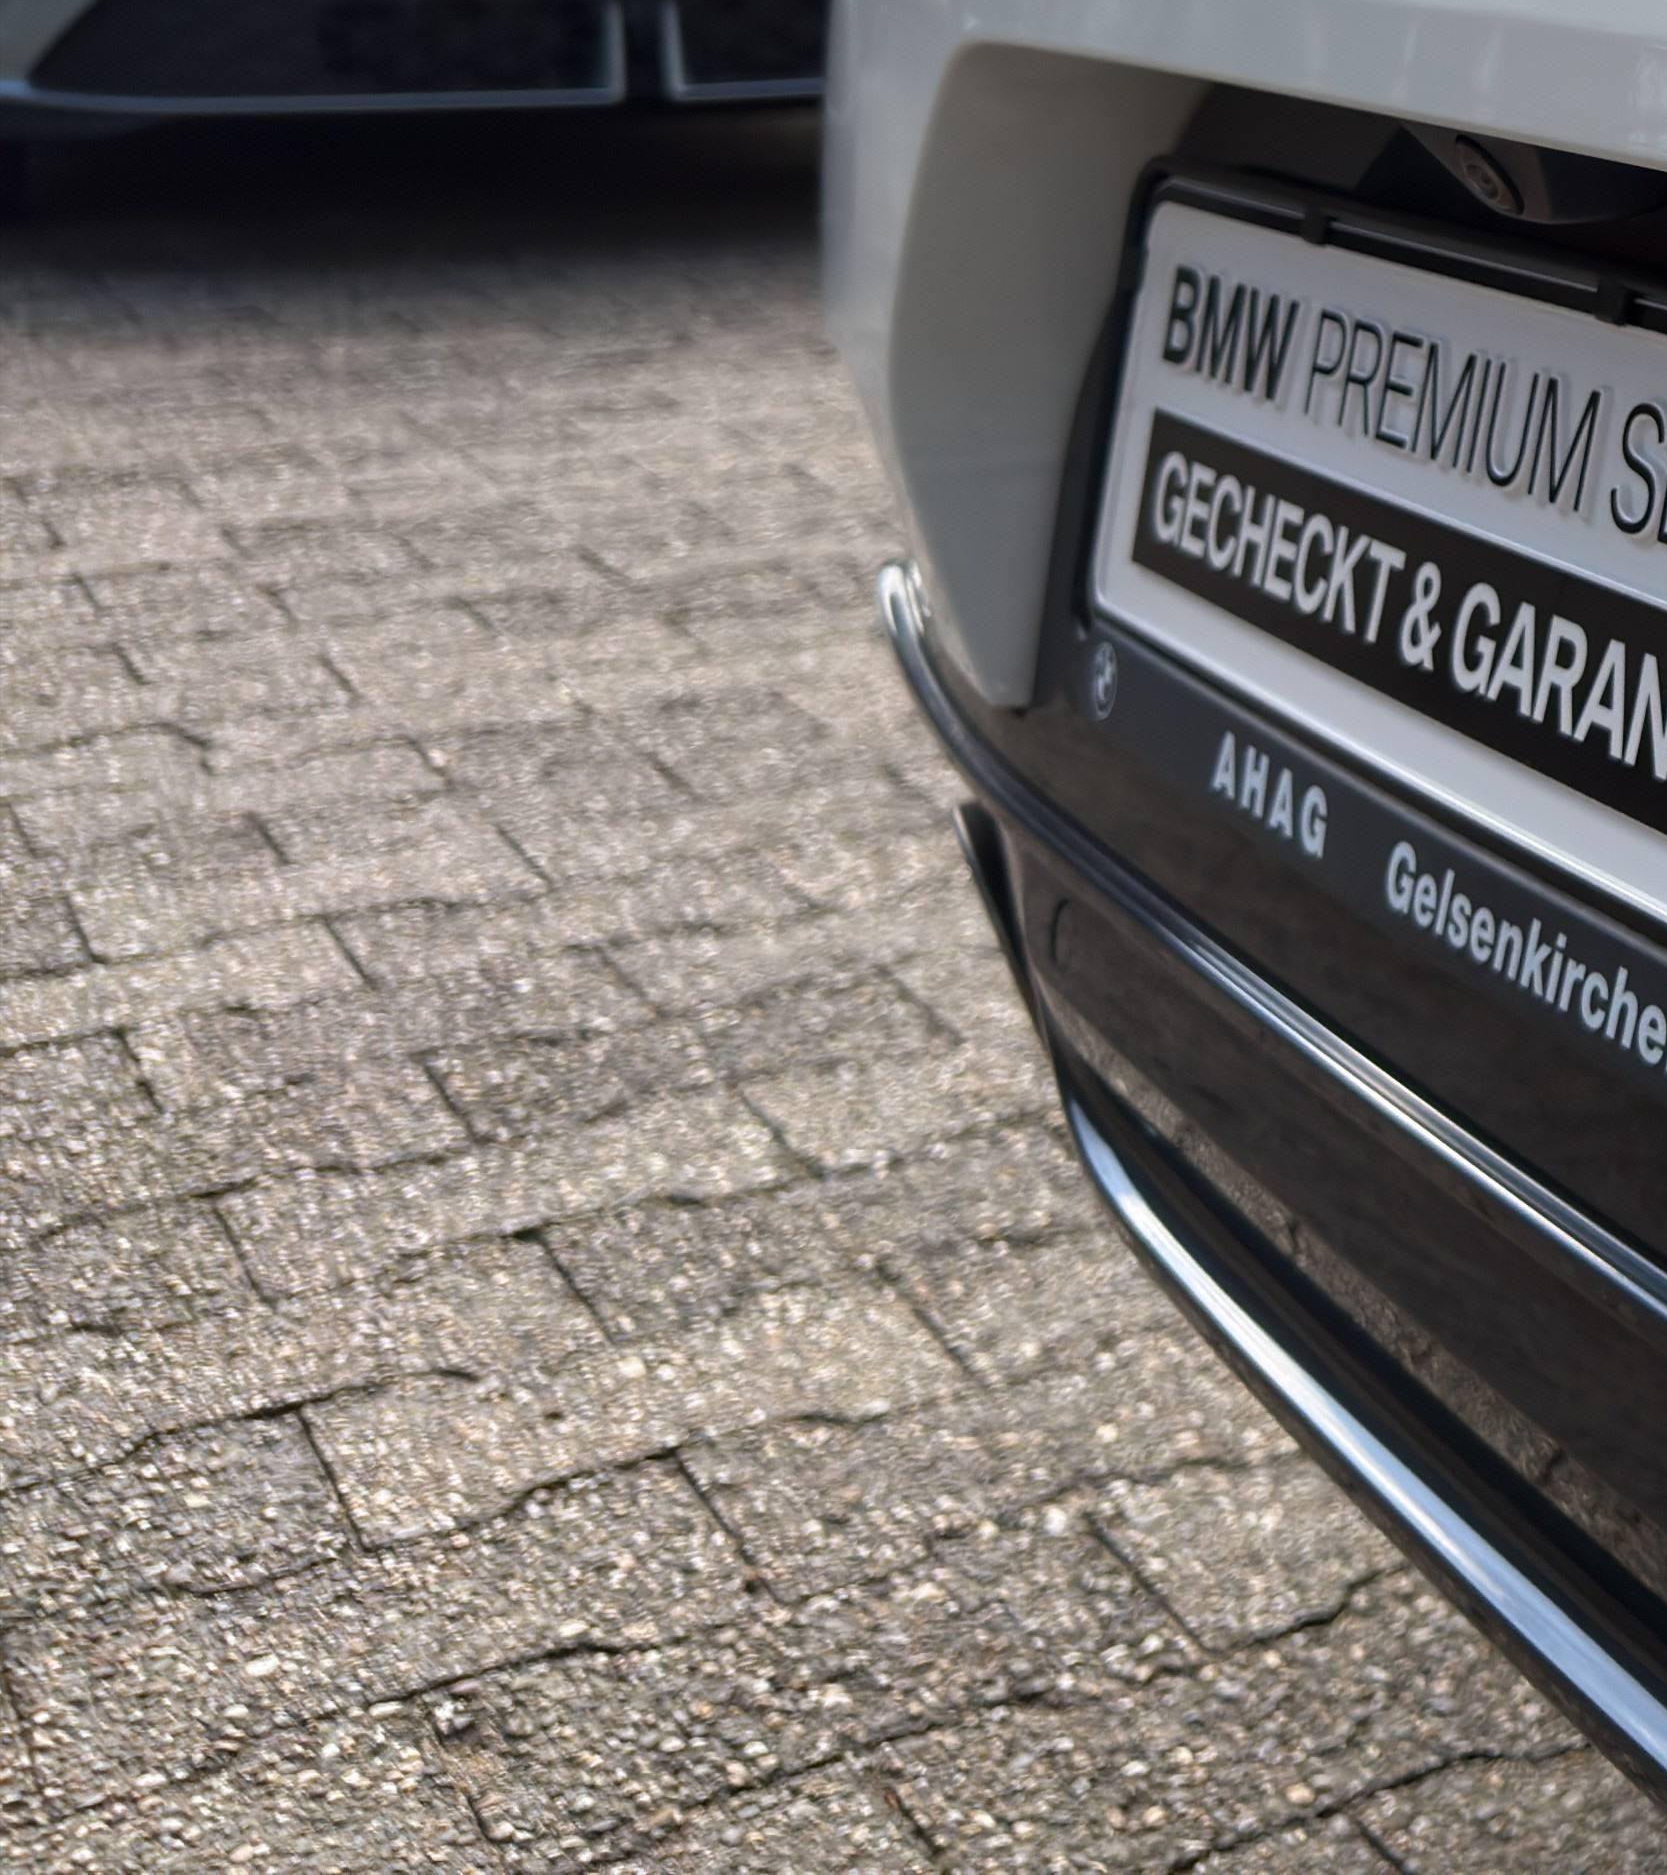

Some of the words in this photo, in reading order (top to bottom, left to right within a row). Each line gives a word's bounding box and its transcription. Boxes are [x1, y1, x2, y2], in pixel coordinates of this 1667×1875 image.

[1162, 264, 1300, 402] BMW
[1302, 307, 1603, 514] PREMIUM
[1153, 450, 1407, 644] GECHECKT
[1400, 560, 1443, 672] &
[1210, 729, 1328, 859] AHAG
